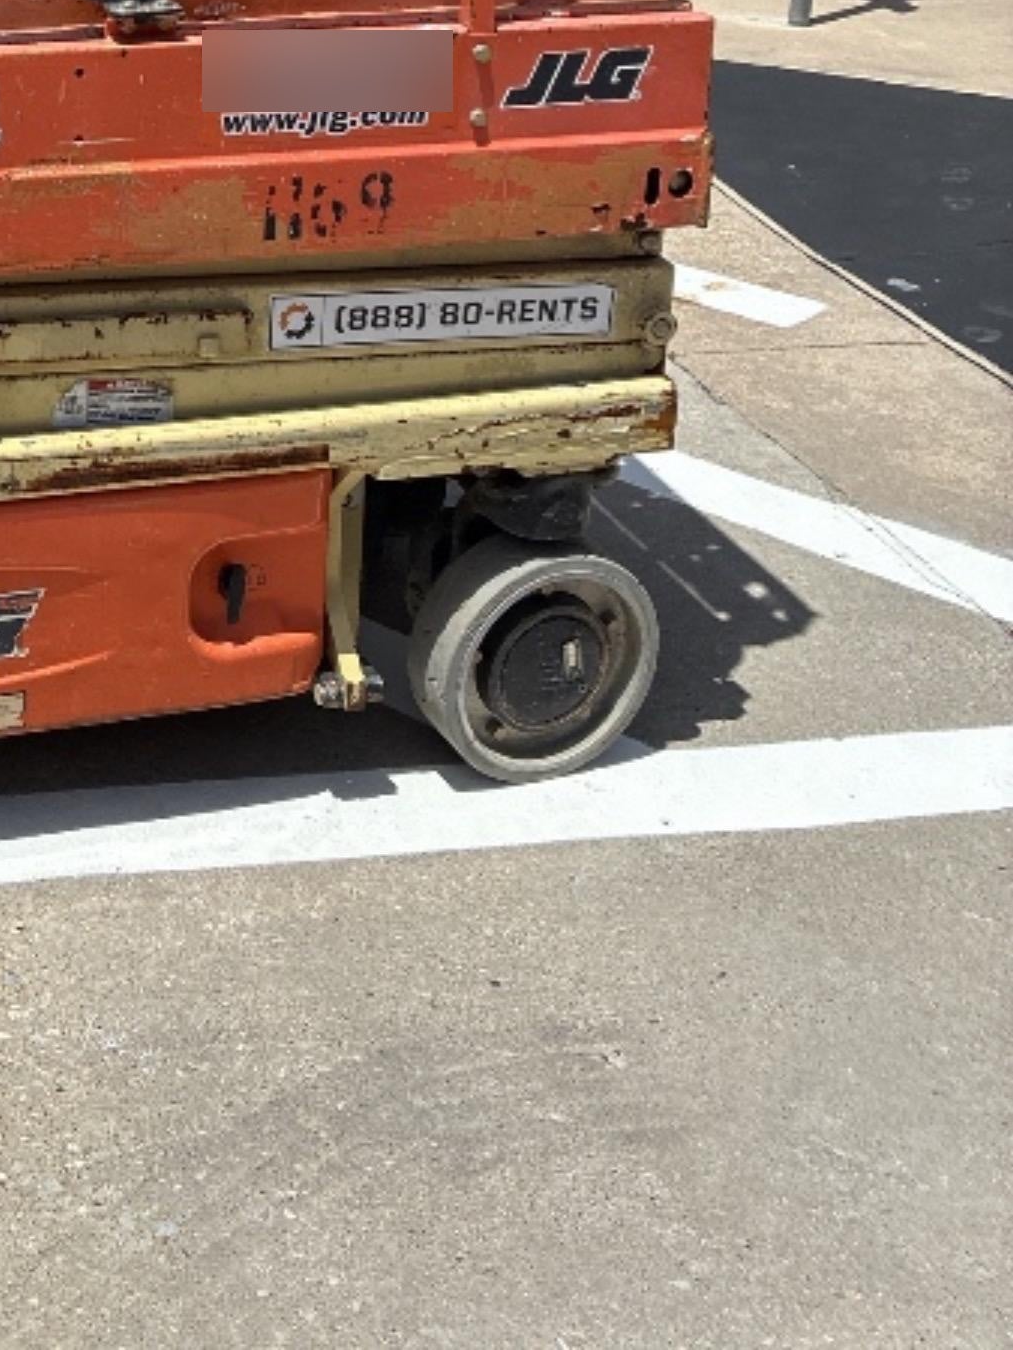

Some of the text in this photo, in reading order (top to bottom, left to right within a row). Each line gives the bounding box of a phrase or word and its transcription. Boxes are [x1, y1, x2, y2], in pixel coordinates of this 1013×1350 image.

[499, 45, 655, 110] JLG
[334, 296, 599, 334] (888) 80-RENTS
